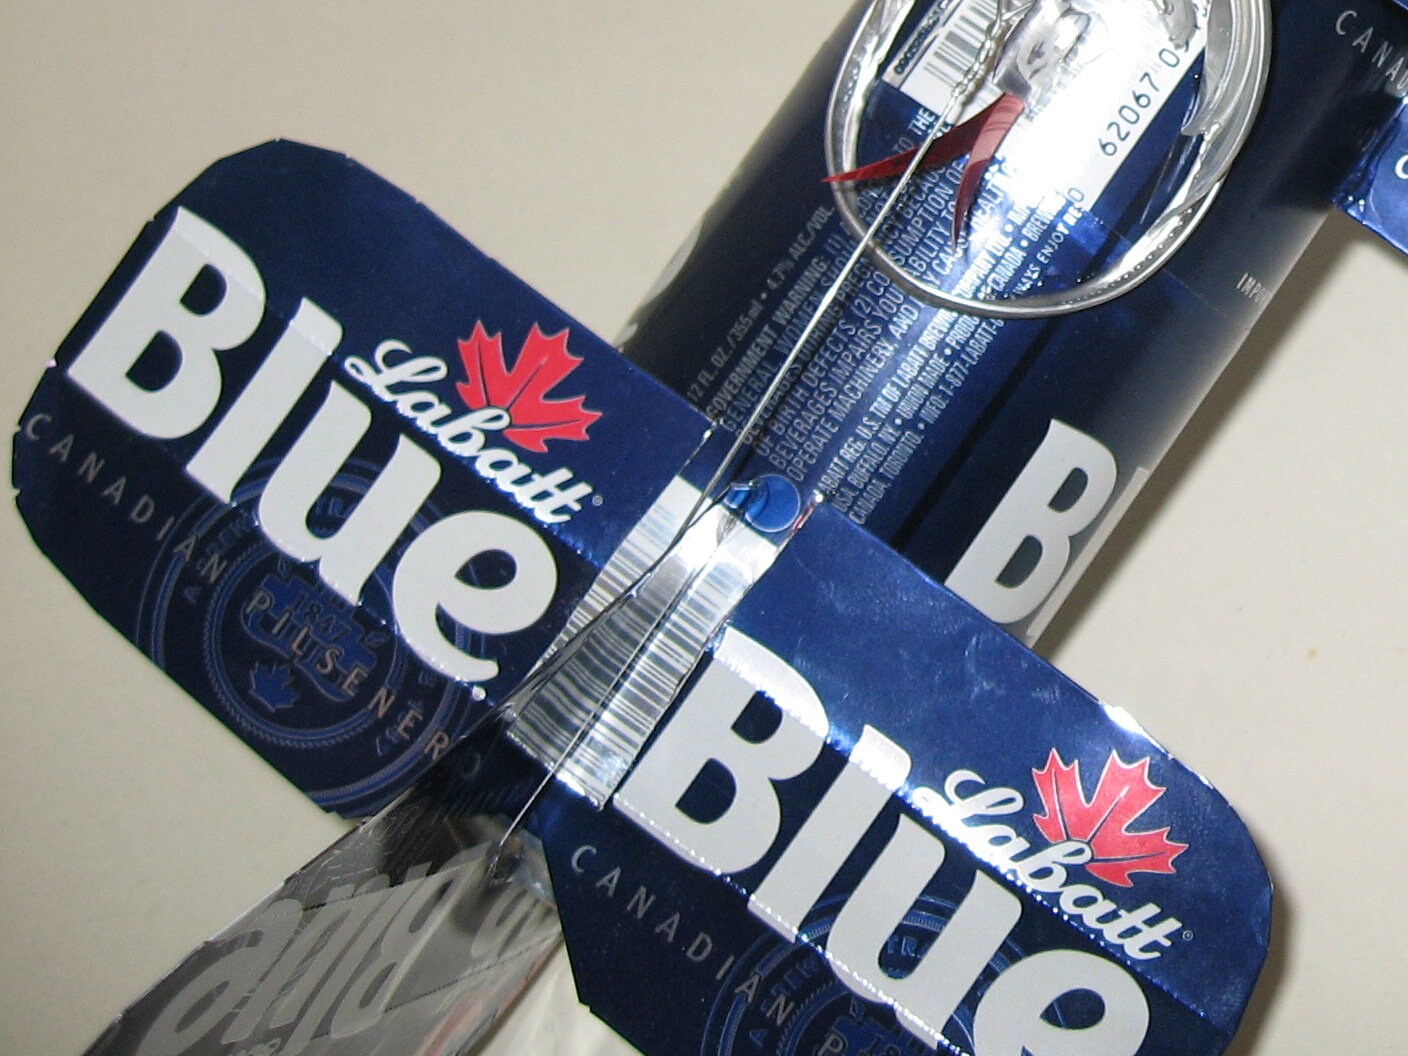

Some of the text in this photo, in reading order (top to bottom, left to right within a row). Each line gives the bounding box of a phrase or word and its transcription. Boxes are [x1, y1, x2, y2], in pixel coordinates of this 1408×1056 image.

[906, 105, 936, 137] THE
[1092, 69, 1166, 159] 62067
[702, 322, 780, 422] GOVERNMENT
[769, 251, 831, 328] WARNING:
[765, 382, 811, 436] BIRTH
[863, 180, 956, 298] COSUMPTION
[766, 378, 840, 470] BEVERAGES
[826, 317, 883, 386] IMPAIRS
[784, 301, 921, 483] OPERATE MACHINERY, AND
[879, 380, 904, 404] OF
[890, 342, 931, 389] LABATT
[894, 380, 930, 421] UNION
[916, 351, 951, 389] MADE
[985, 243, 1028, 292] CANADA
[916, 302, 959, 352] BREWIN
[918, 390, 950, 425] INFO:
[1034, 221, 1072, 265] ENJOY
[67, 205, 559, 683] Blue
[342, 339, 586, 525] Labatt
[837, 432, 867, 464] REG.
[867, 395, 893, 421] TM
[26, 412, 451, 757] CANADIAN PILSENER
[288, 589, 354, 647] 1847
[614, 626, 1151, 1056] Blue
[911, 767, 1182, 963] Labatt
[571, 844, 795, 1026] CANADIAN
